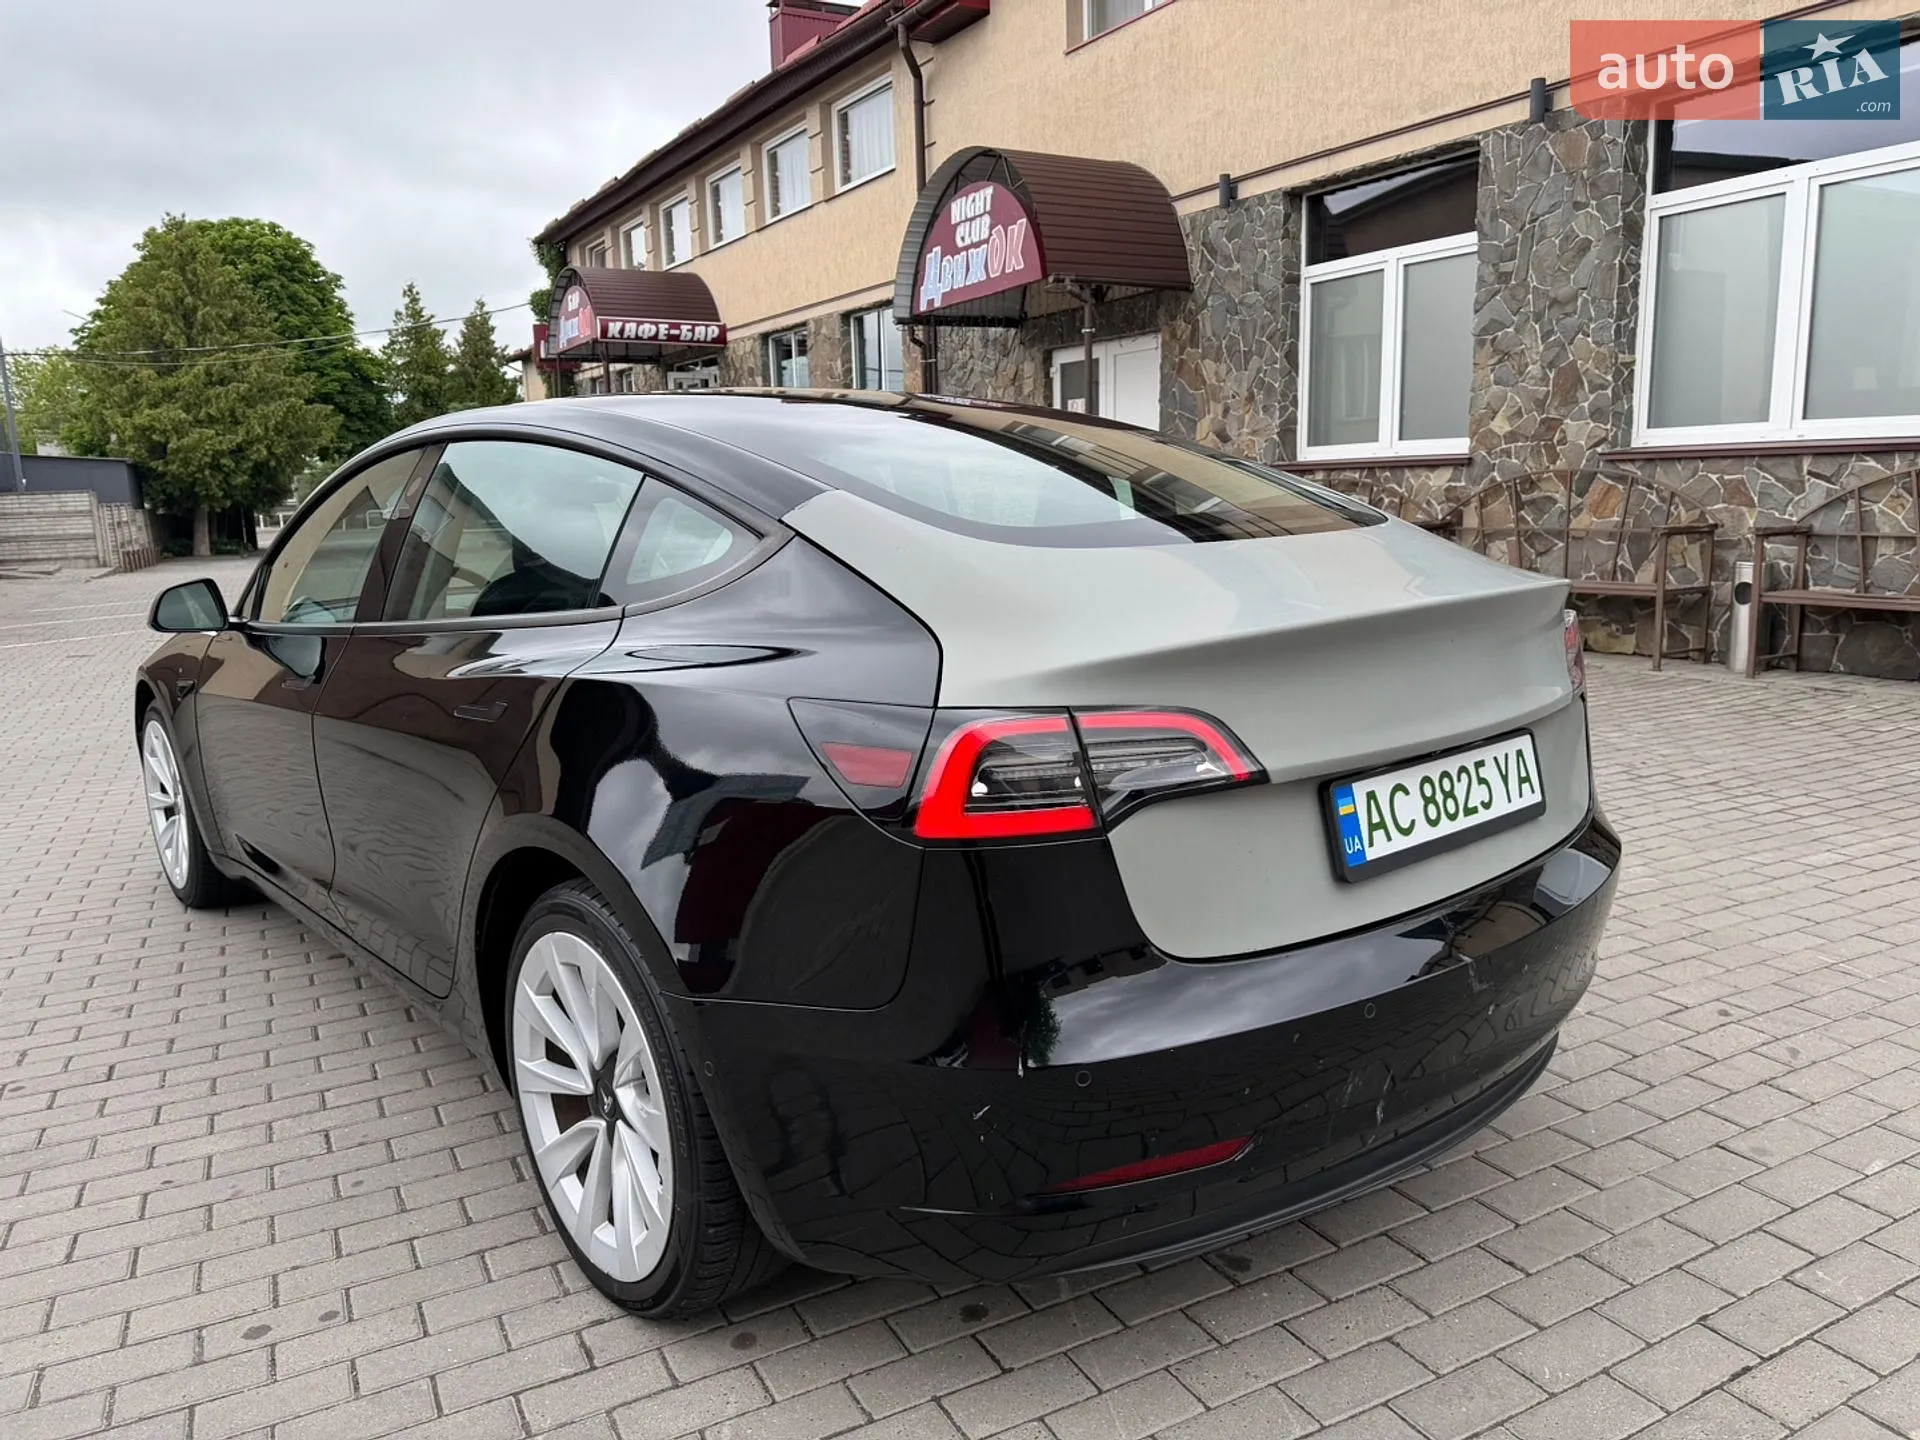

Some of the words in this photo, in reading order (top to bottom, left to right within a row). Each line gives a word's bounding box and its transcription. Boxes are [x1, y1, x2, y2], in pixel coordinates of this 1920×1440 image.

[951, 186, 994, 225] NIGHT
[955, 213, 991, 248] CLUB
[607, 321, 720, 342] КАФЕ-БАР
[1366, 782, 1416, 848] AC
[1419, 758, 1493, 828] 8825
[1494, 748, 1535, 804] YA
[1344, 838, 1363, 855] UA
